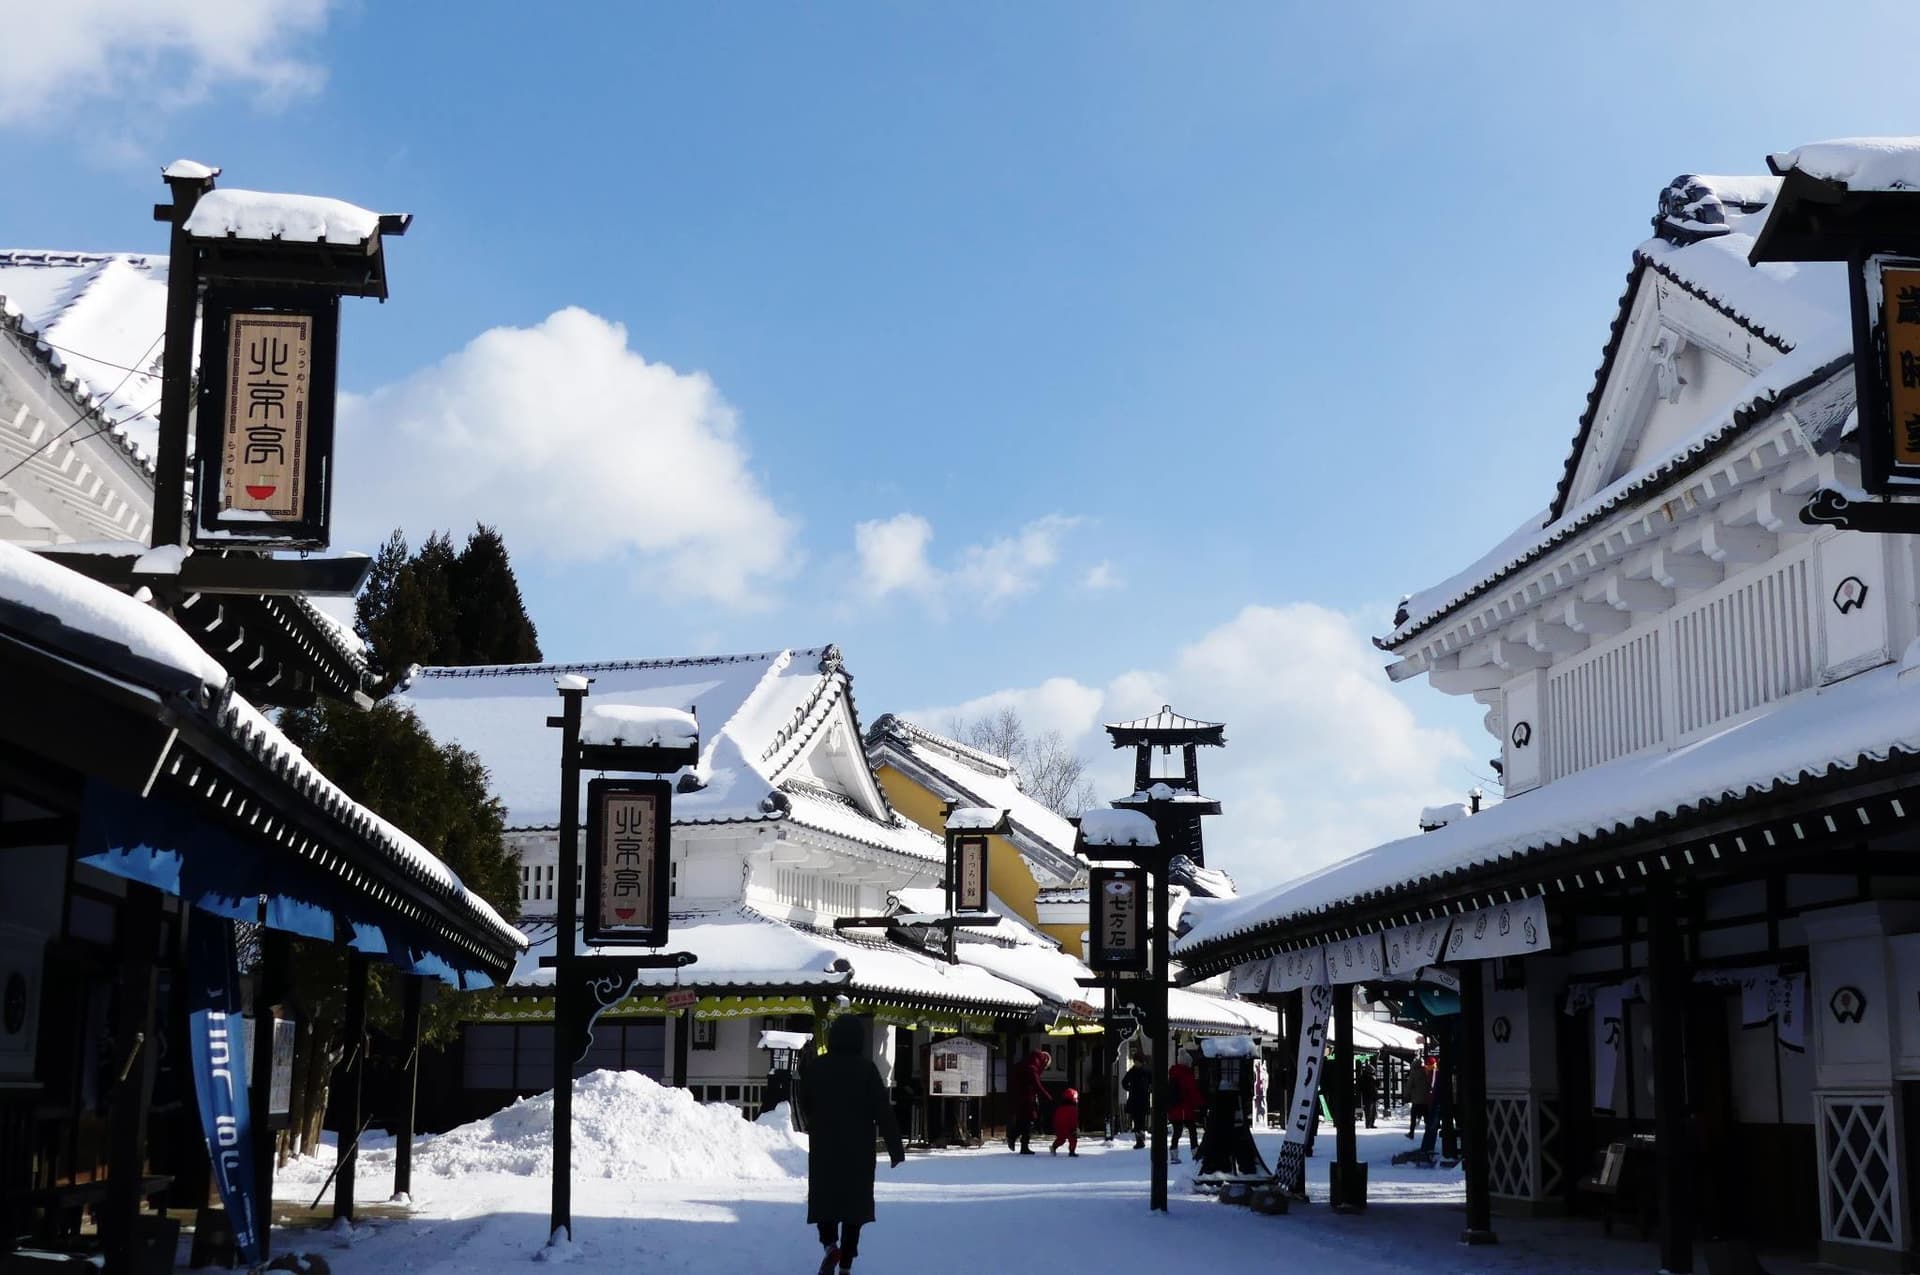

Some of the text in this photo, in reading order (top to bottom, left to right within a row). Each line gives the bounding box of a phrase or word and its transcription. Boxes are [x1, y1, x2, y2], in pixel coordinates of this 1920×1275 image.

[244, 337, 289, 466] 北京亭
[613, 806, 643, 897] 北京亭
[1109, 895, 1128, 946] 七万石
